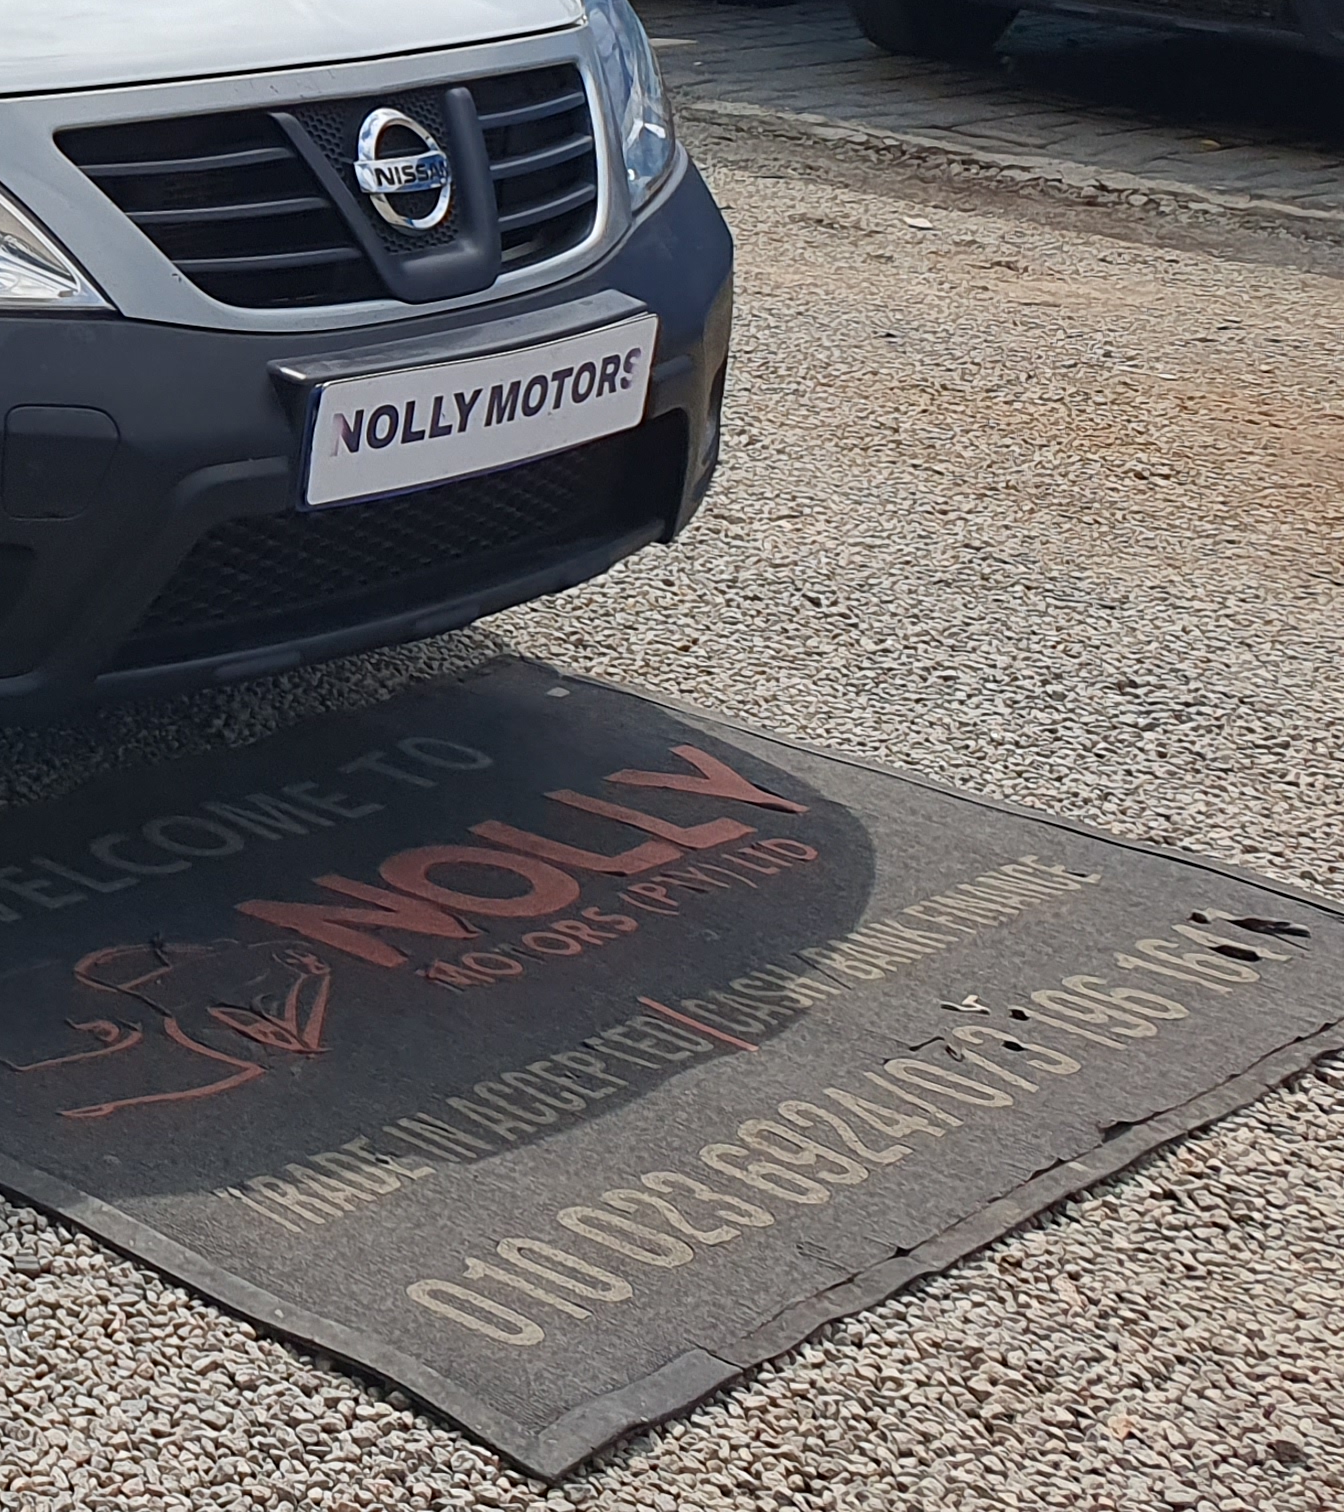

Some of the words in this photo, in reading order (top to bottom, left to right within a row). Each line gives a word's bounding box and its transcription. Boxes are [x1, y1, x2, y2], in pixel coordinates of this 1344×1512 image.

[330, 387, 483, 457] NOLLY
[483, 347, 642, 428] MOTORS
[337, 735, 495, 788] TO
[233, 743, 810, 968] NOLLY
[720, 837, 820, 876] LTD
[213, 1137, 438, 1234] TRADE
[381, 1111, 495, 1164] IN
[902, 855, 1103, 934] FINANCE
[405, 1237, 634, 1346] 010
[556, 1170, 776, 1269] 023
[1008, 974, 1190, 1051] 196
